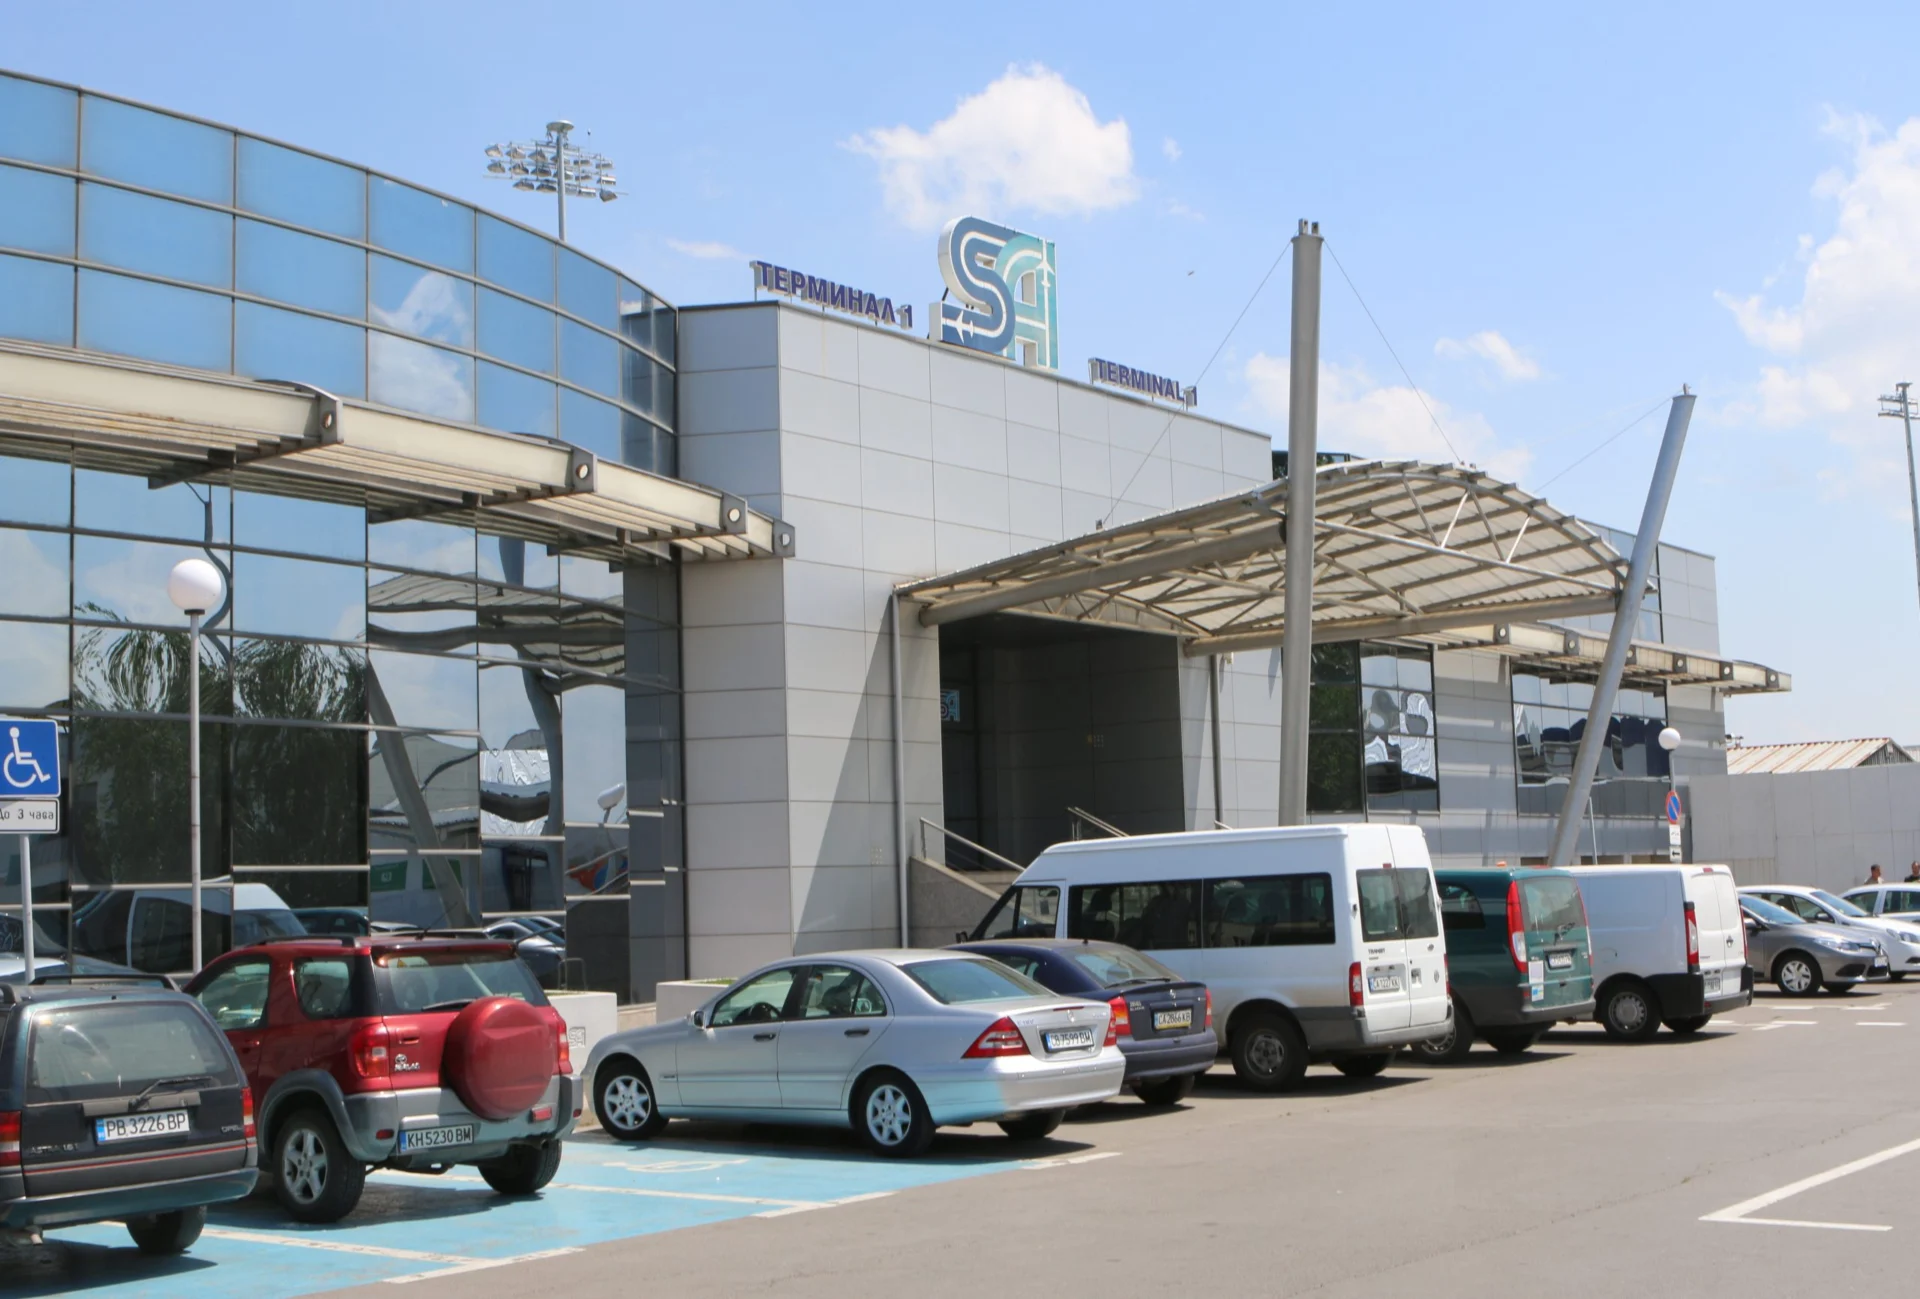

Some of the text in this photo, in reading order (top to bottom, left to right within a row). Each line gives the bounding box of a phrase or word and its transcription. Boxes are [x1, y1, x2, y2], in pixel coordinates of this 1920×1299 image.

[754, 261, 913, 328] ТЕРМИНАЛ 1
[1092, 357, 1185, 401] TERMINAL
[18, 808, 24, 820] 3
[29, 811, 54, 820] часа
[1060, 1033, 1079, 1045] 7599
[106, 1112, 186, 1138] PB 3226 BP
[407, 1127, 471, 1148] KH 5230 BM
